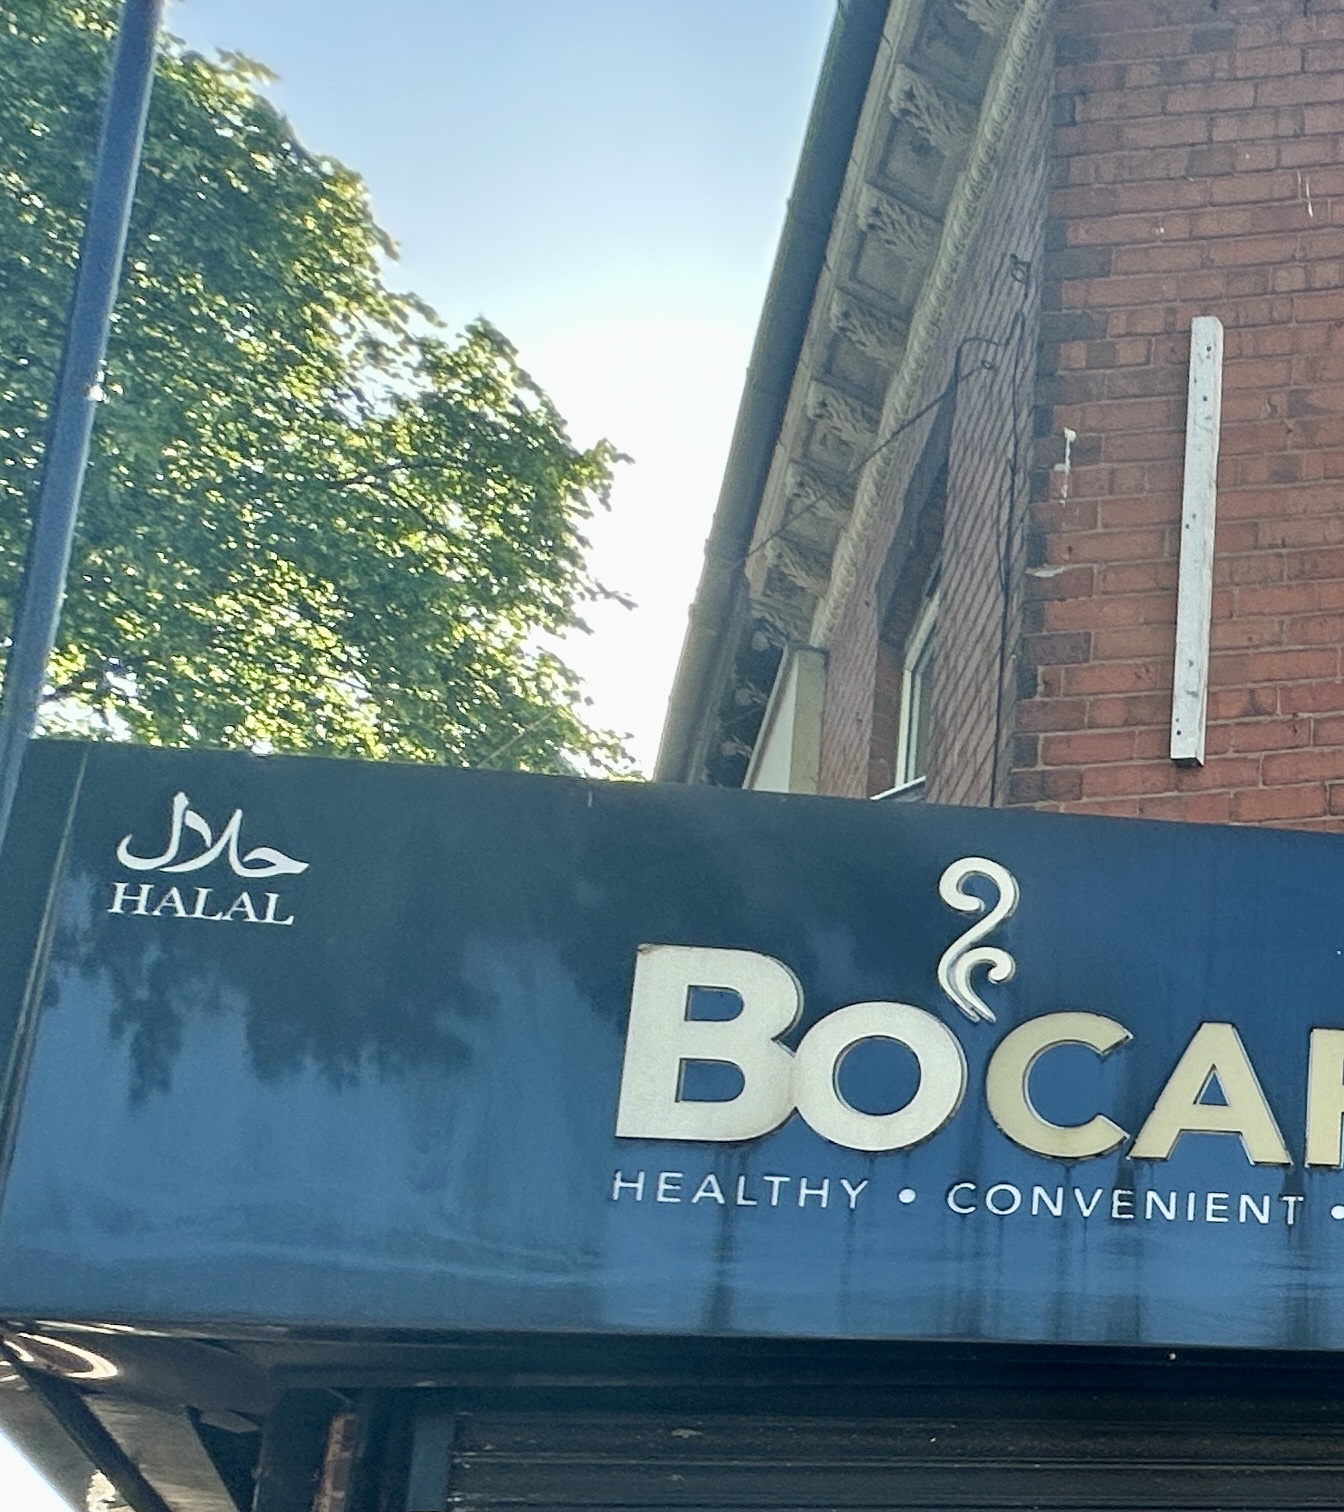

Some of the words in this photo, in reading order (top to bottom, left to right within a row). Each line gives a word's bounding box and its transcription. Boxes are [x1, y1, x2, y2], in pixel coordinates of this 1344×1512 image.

[117, 791, 309, 878] حلال
[107, 882, 294, 926] HALAL
[612, 1170, 869, 1209] HEALTHY
[947, 1181, 1304, 1227] CONVENIENT
